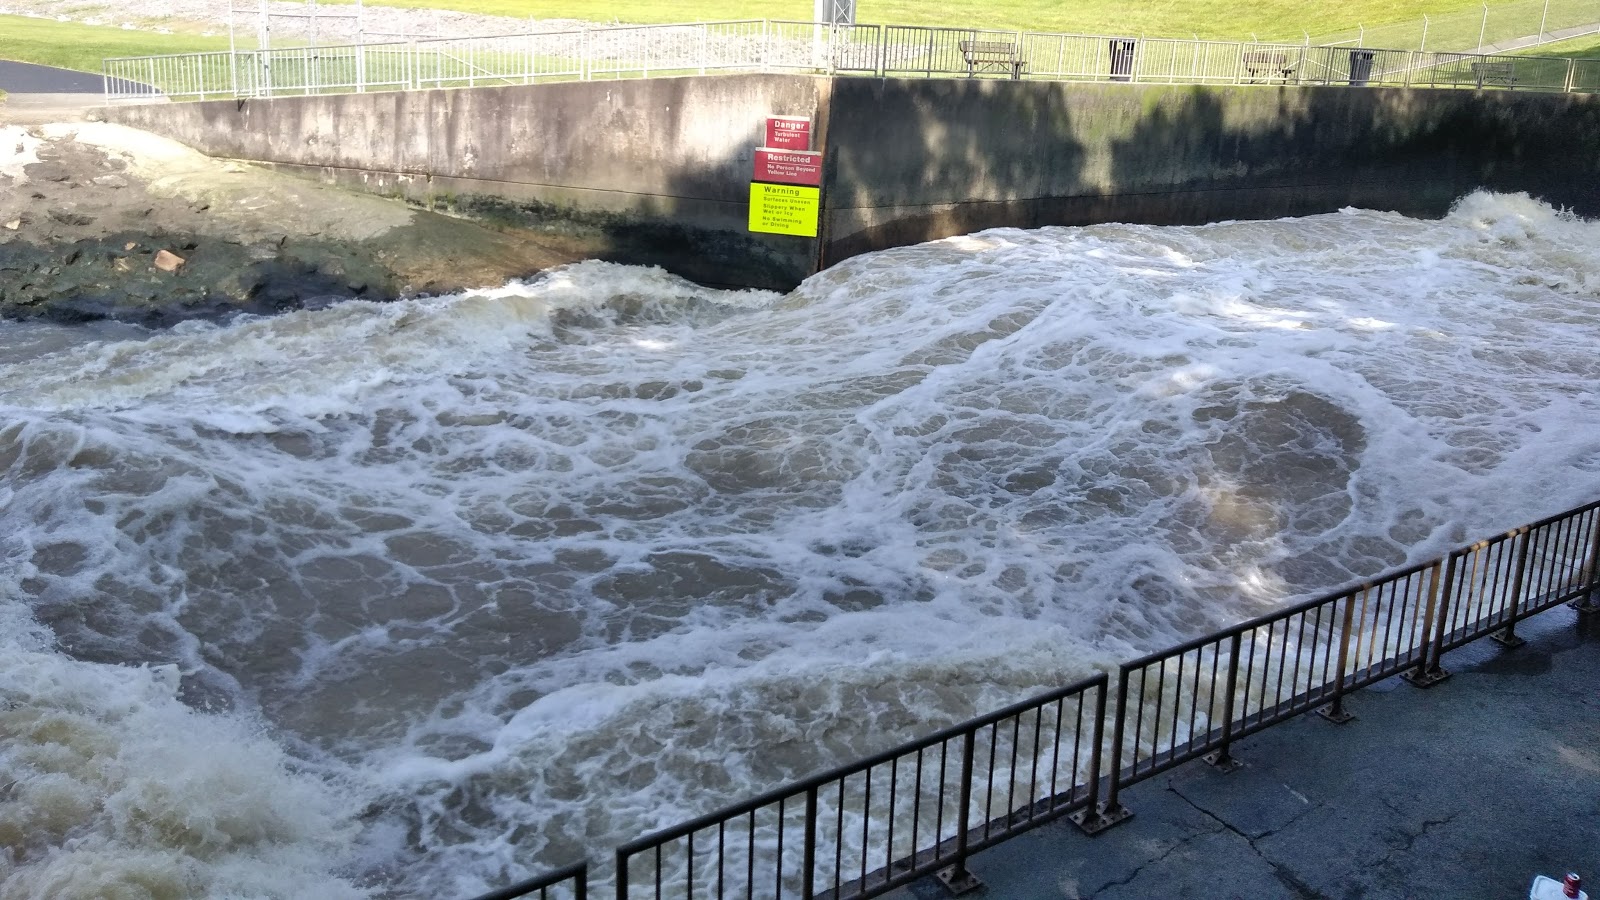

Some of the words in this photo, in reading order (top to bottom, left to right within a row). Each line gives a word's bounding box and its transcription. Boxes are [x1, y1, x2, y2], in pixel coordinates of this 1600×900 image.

[774, 120, 804, 130] Danger
[768, 154, 810, 163] Restricted
[764, 186, 800, 196] Warning
[772, 216, 802, 224] Swimming
